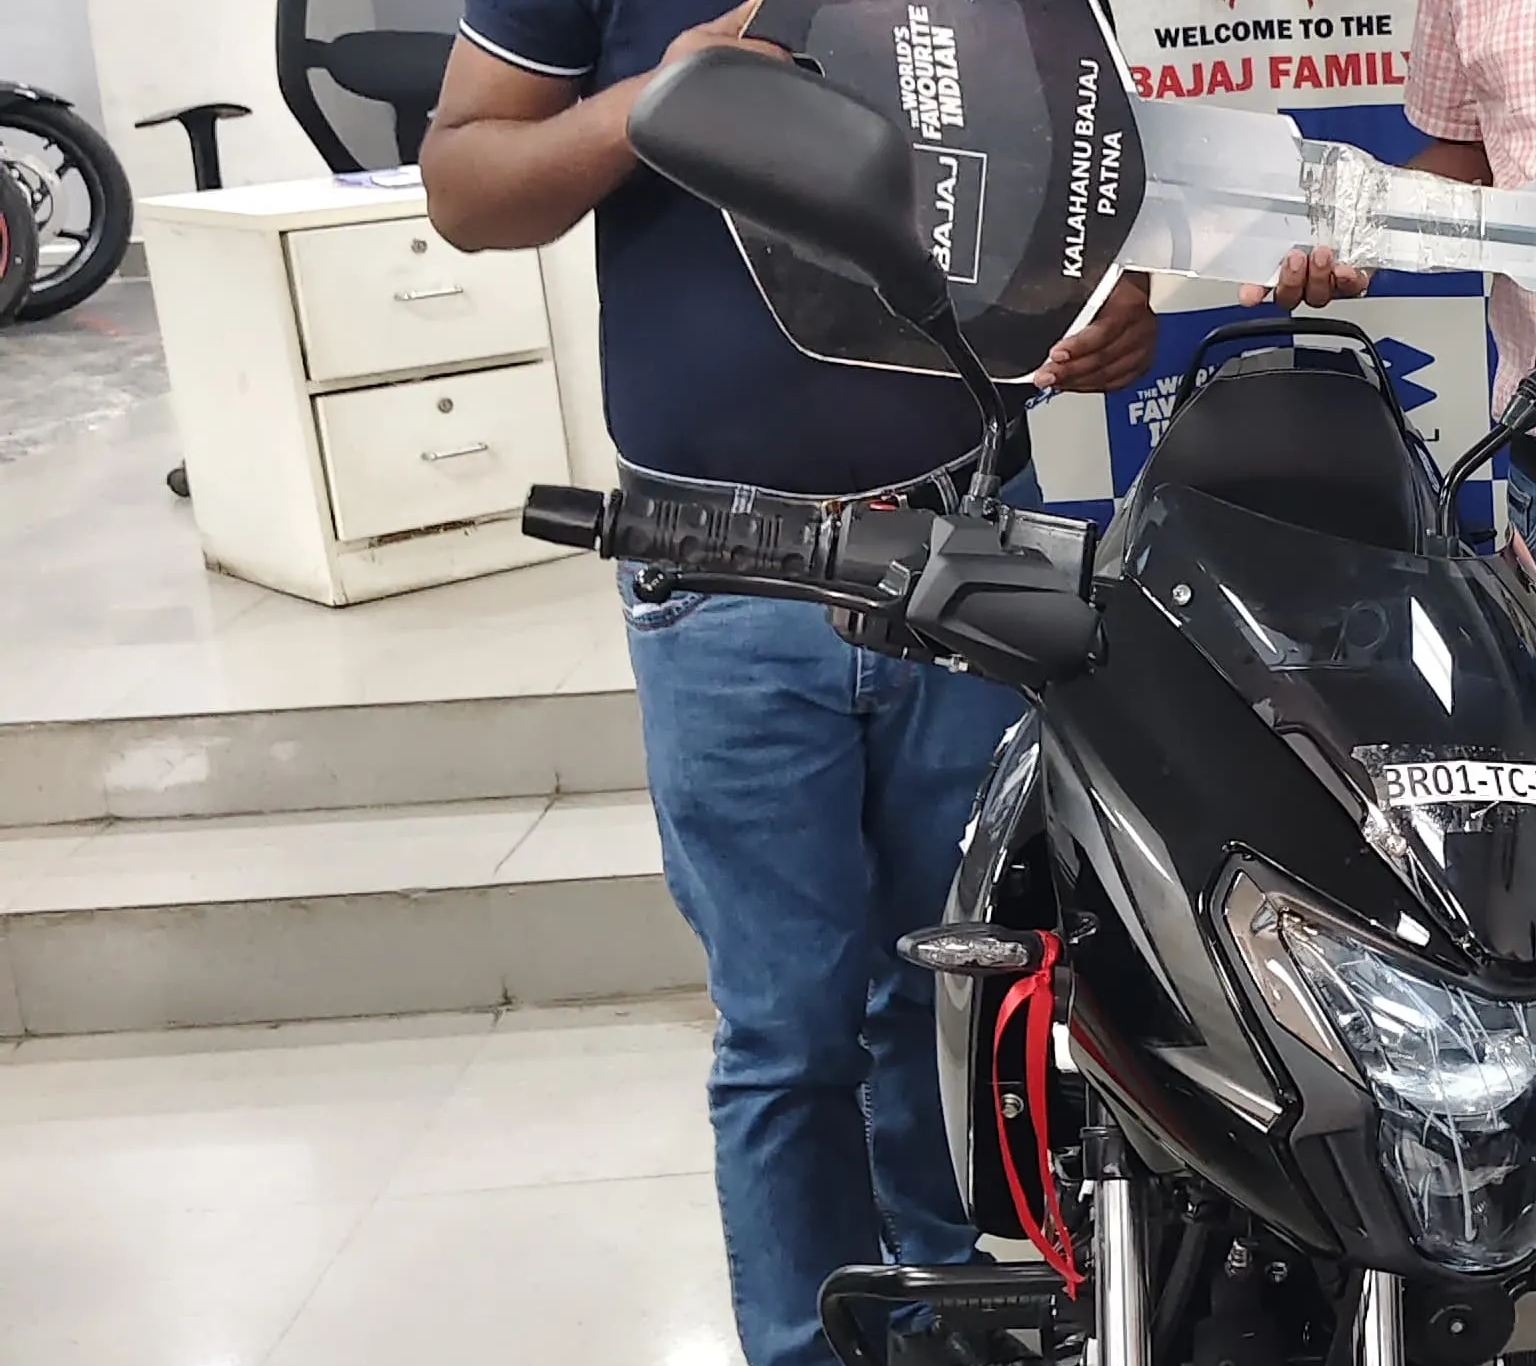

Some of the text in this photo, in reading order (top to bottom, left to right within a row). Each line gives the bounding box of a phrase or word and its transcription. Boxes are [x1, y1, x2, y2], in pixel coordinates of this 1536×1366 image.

[894, 25, 918, 111] WORLD'S
[908, 4, 943, 140] FAVOURITE
[1154, 14, 1392, 48] WELCOME TO THE
[930, 25, 965, 128] INDIAN
[1131, 57, 1252, 99] BAJAJ
[1062, 59, 1100, 278] KALAHANU BAJAJ
[1097, 131, 1123, 215] PATNA
[932, 154, 959, 273] BAJAJ
[1136, 387, 1159, 399] THE
